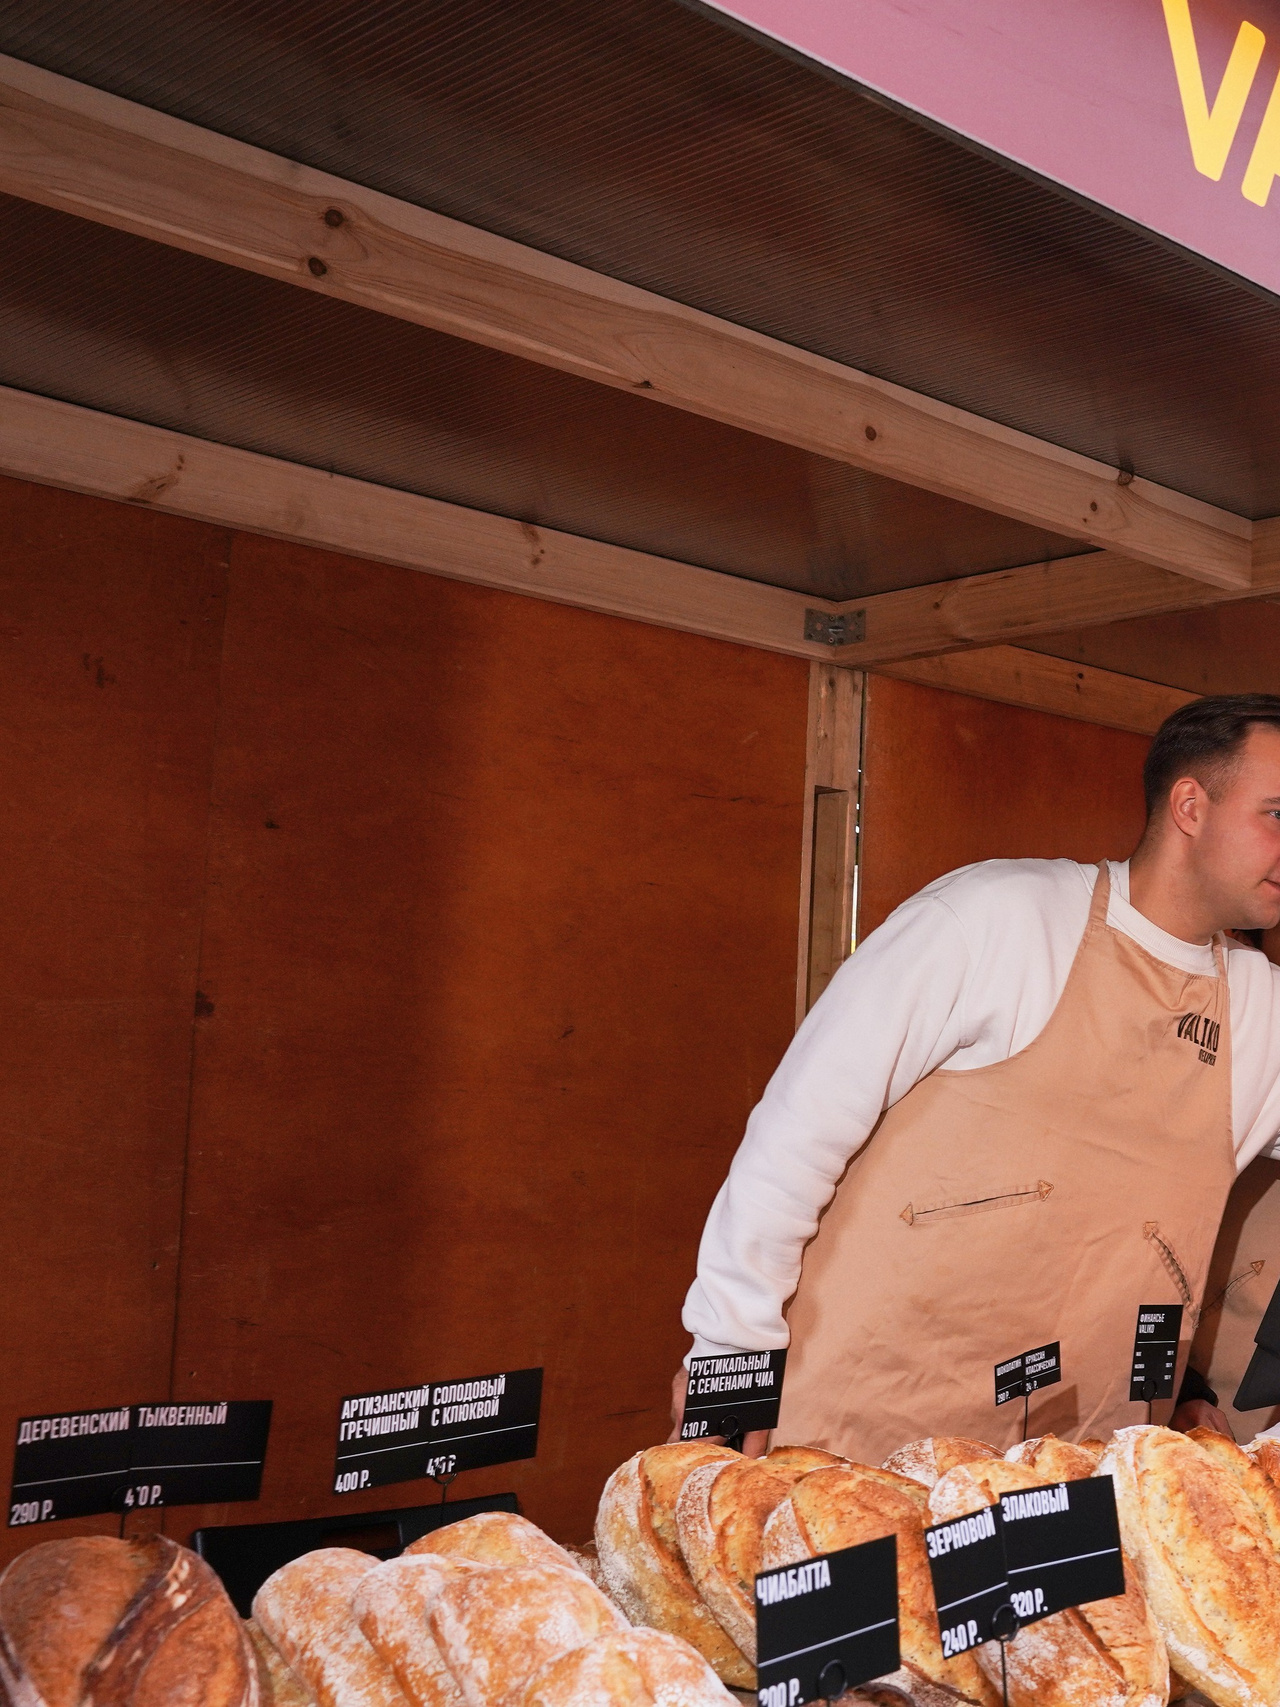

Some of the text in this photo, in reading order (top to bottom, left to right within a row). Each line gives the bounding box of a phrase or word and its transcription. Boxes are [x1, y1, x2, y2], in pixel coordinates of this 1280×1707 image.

[1177, 1012, 1220, 1052] VALIKO
[690, 1351, 771, 1377] РУСТИКАЛЬНЫЙ
[433, 1374, 506, 1406] СОЛОДОВЫЙ
[688, 1370, 774, 1396] С СЕМЕНАМИ ЧИА
[138, 1402, 229, 1428] ТЫКВЕННЫЙ
[341, 1384, 430, 1420] АРТИЗАНСКИЙ
[431, 1396, 500, 1427] С КЛЮКВОЙ
[17, 1407, 130, 1446] ДЕРЕВЕНСКИЙ
[339, 1407, 420, 1442] ГРЕЧИШНЫЙ
[681, 1420, 709, 1438] 410 Р.
[124, 1485, 164, 1507] 40 Р.
[334, 1469, 372, 1493] 400 Р.
[9, 1499, 57, 1527] 290 Р.
[1001, 1483, 1070, 1523] ЗЛАКОВЫЙ
[926, 1506, 997, 1559] ЗЕРНОВОЙ
[756, 1559, 832, 1606] ЧИАБАТТА
[1010, 1587, 1049, 1618] 320 Р.
[941, 1620, 983, 1660] 240 Р.
